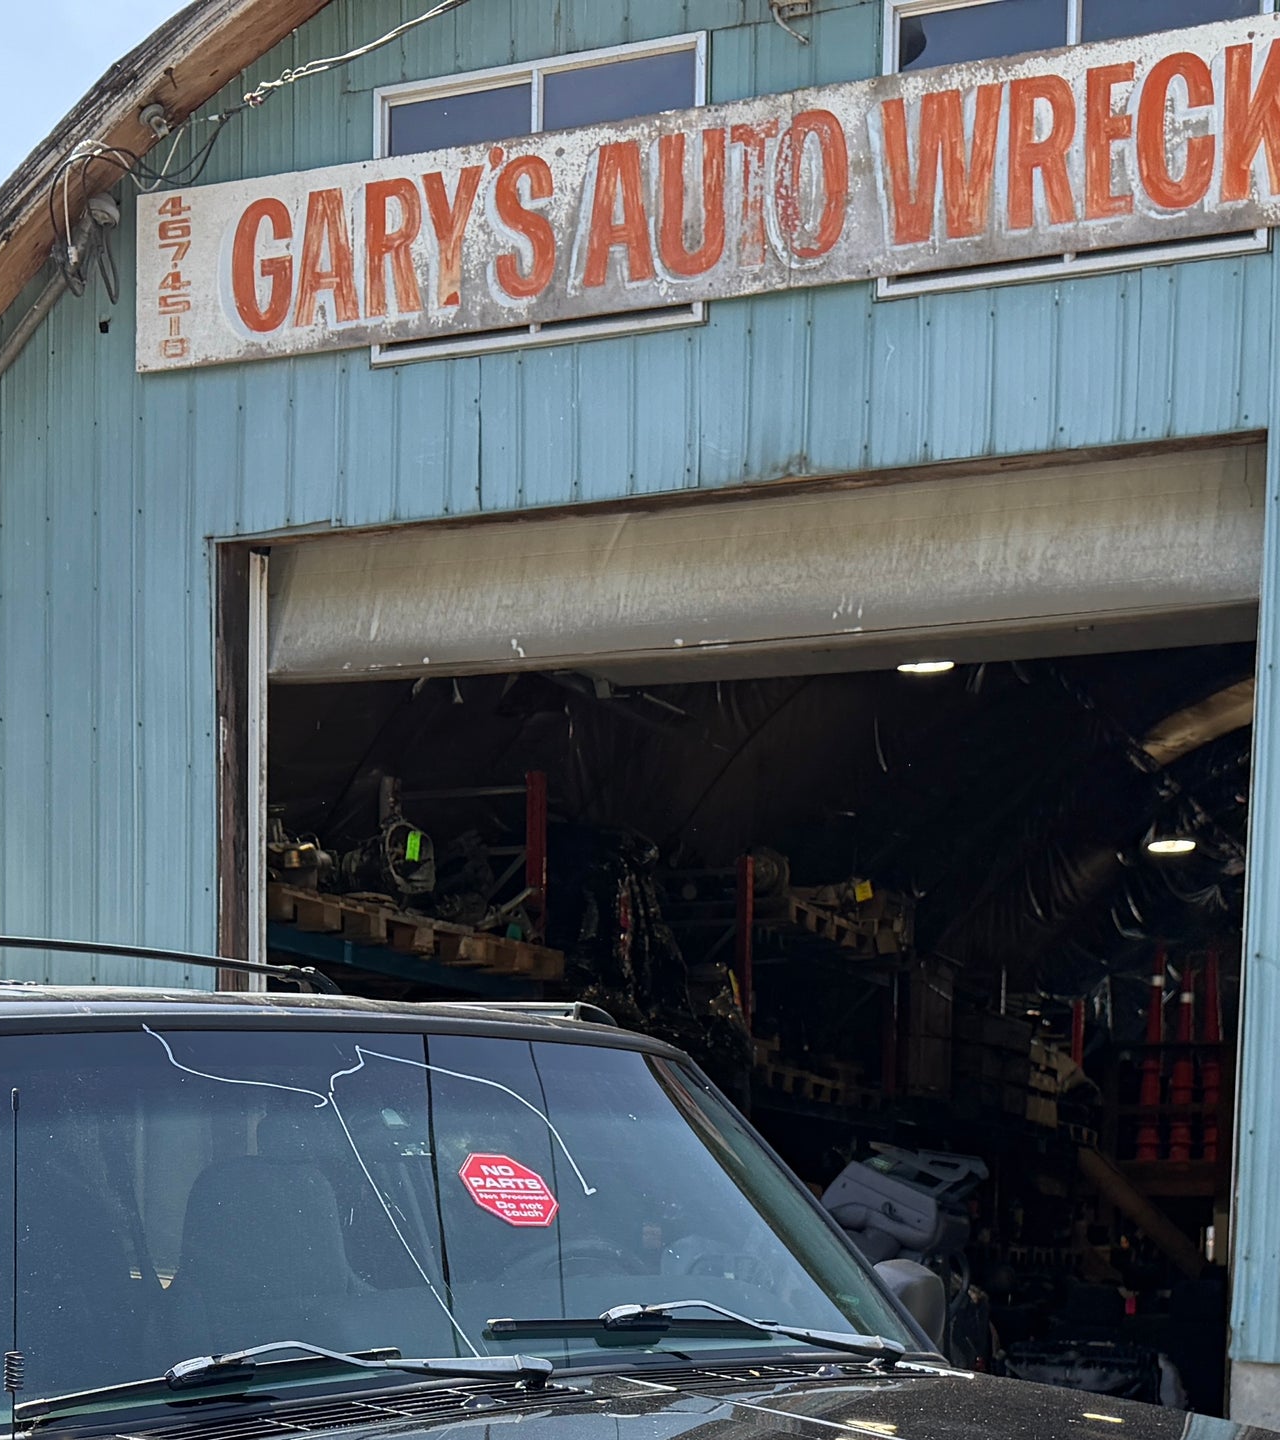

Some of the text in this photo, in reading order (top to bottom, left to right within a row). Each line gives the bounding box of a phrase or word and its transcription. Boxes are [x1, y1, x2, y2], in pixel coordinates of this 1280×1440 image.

[231, 146, 555, 333] GARY'S
[580, 109, 849, 288] AUTO
[479, 1164, 516, 1177] NO
[468, 1176, 542, 1190] PARTS
[495, 1200, 544, 1210] Do not
[503, 1209, 544, 1217] touch
